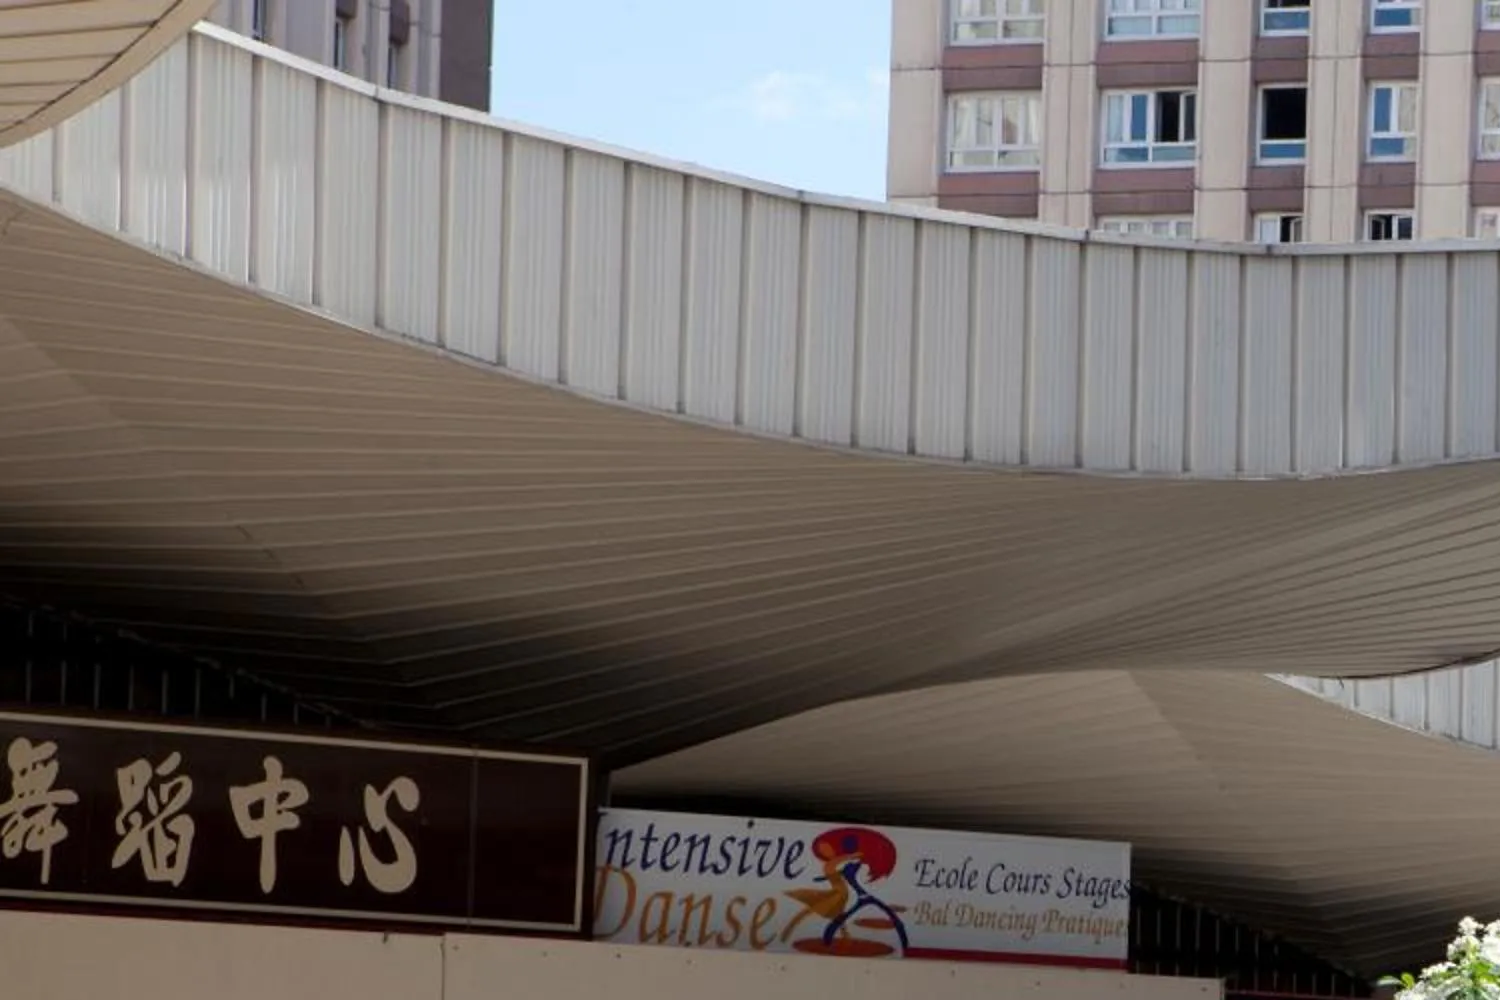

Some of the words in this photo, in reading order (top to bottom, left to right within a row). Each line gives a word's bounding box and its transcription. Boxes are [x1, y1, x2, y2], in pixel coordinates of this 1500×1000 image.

[600, 812, 804, 879] ntensive
[593, 866, 777, 950] Danse
[914, 856, 978, 891] Ecole
[986, 863, 1052, 894] Cours
[1056, 866, 1131, 908] Stages
[913, 899, 949, 926] Bal
[955, 902, 1037, 939] Dancing
[1042, 907, 1128, 944] Pratique
